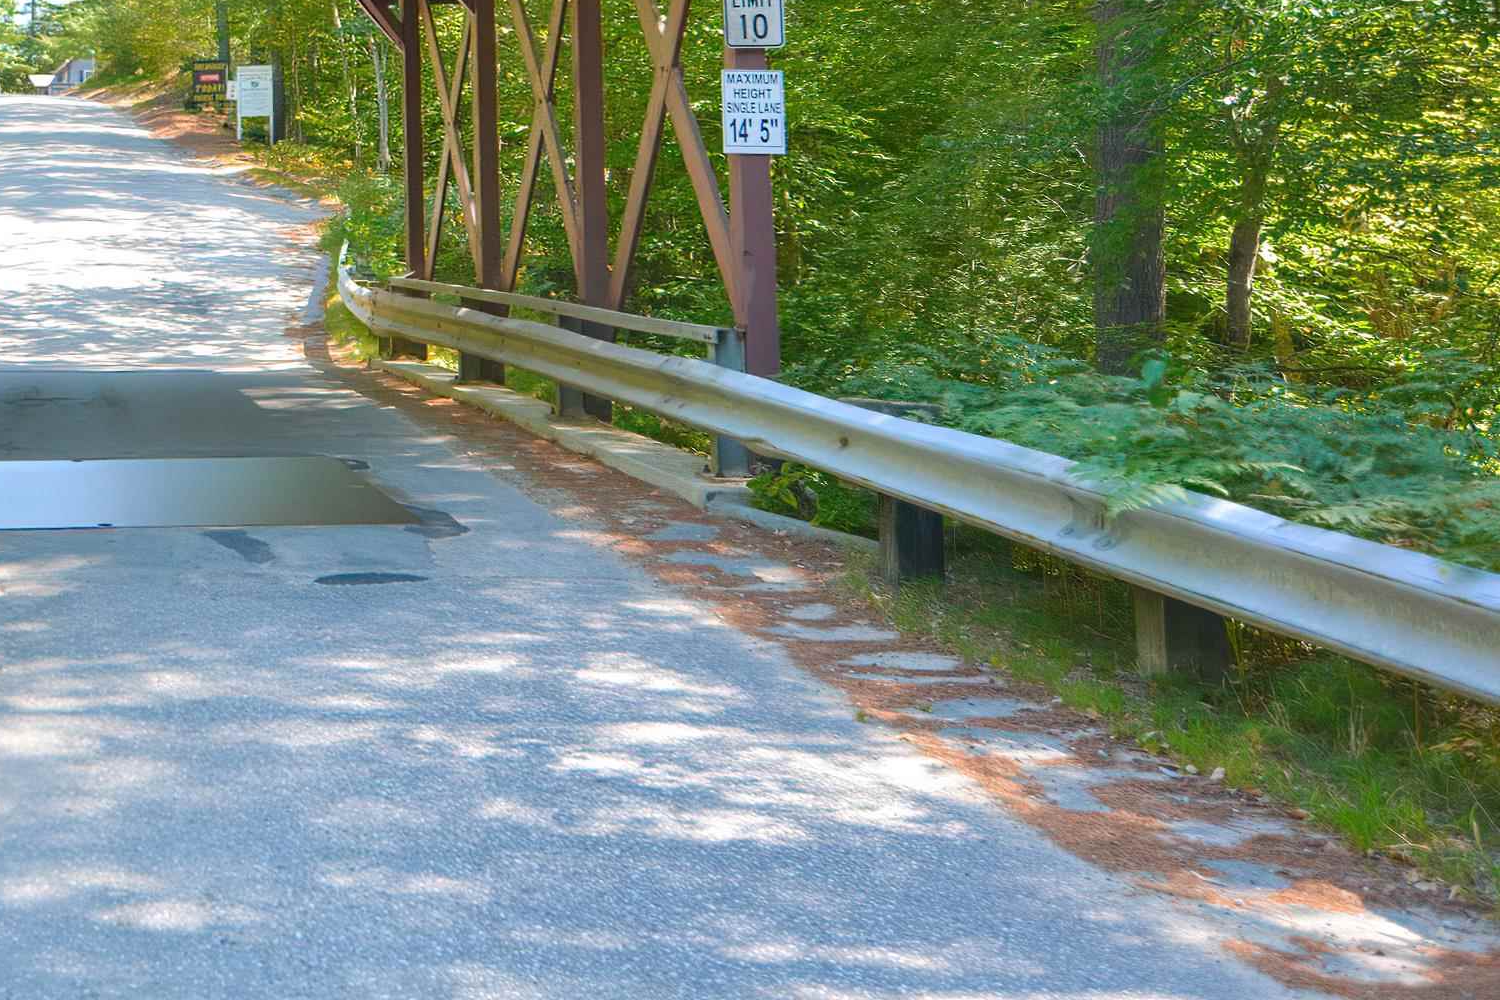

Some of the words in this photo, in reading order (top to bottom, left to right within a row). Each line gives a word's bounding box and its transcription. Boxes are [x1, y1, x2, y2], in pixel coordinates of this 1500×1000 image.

[740, 14, 768, 40] 10
[726, 74, 779, 85] MAXIMUM
[733, 89, 773, 99] HEIGHT
[726, 102, 757, 114] SINGLE
[758, 102, 781, 114] LANE
